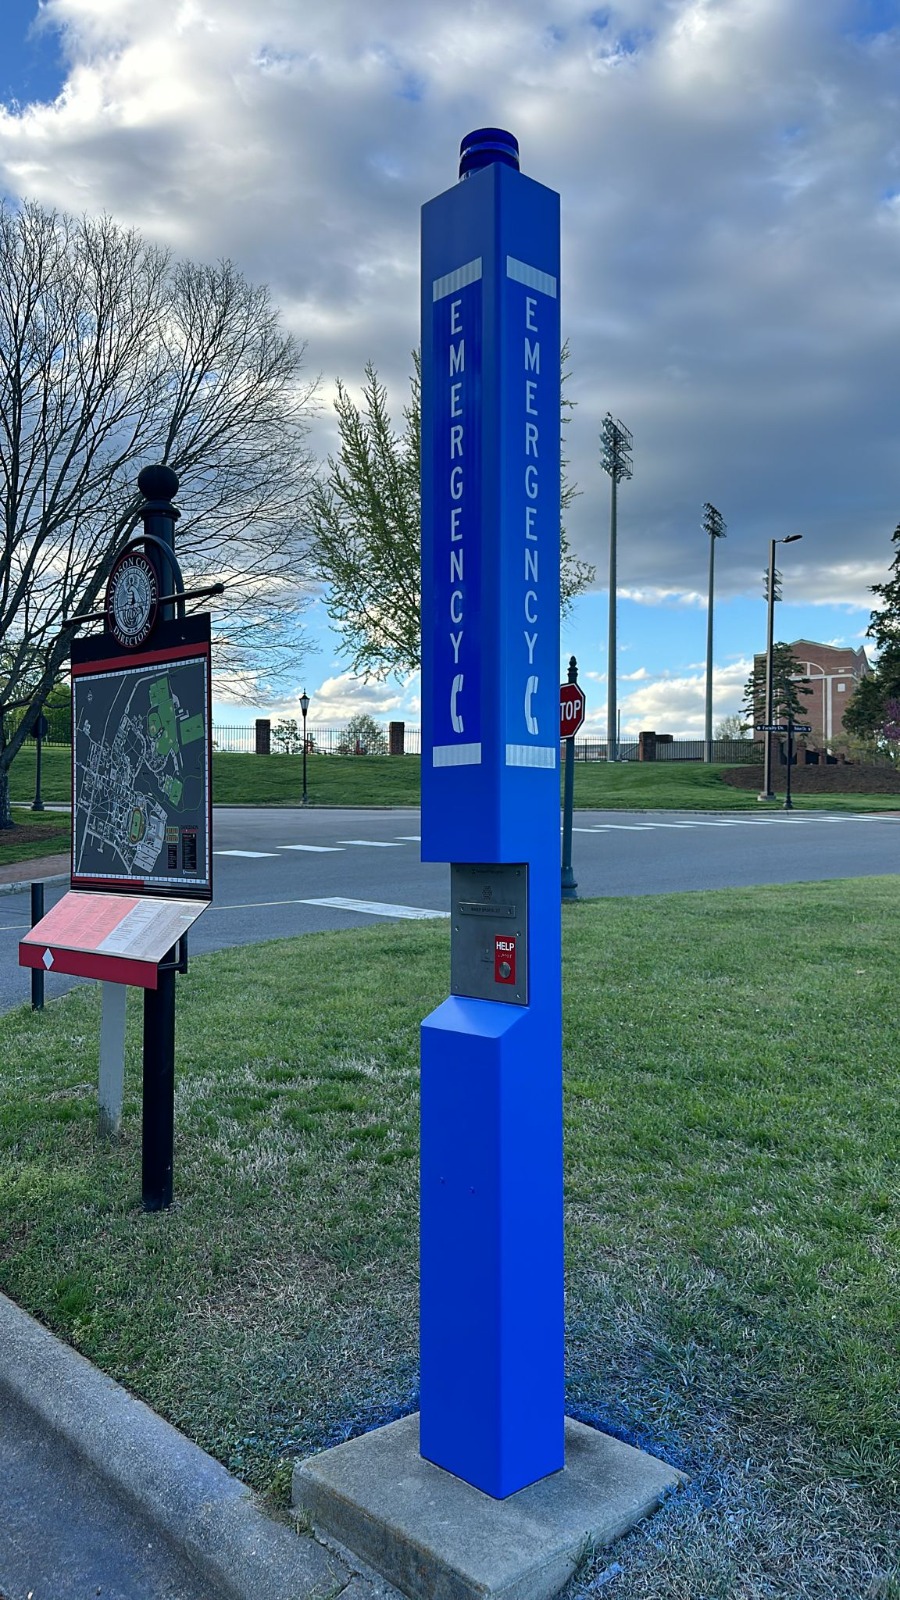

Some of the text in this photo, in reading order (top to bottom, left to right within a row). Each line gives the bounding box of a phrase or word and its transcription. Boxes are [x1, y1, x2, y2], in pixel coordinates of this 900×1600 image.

[449, 298, 465, 665] EMERGENCY
[524, 296, 539, 666] EMERGENCY
[109, 557, 157, 614] DAVIDSON COLLEGE
[113, 620, 151, 646] DIRECTORY
[560, 699, 581, 721] TOP
[496, 941, 515, 951] HELP
